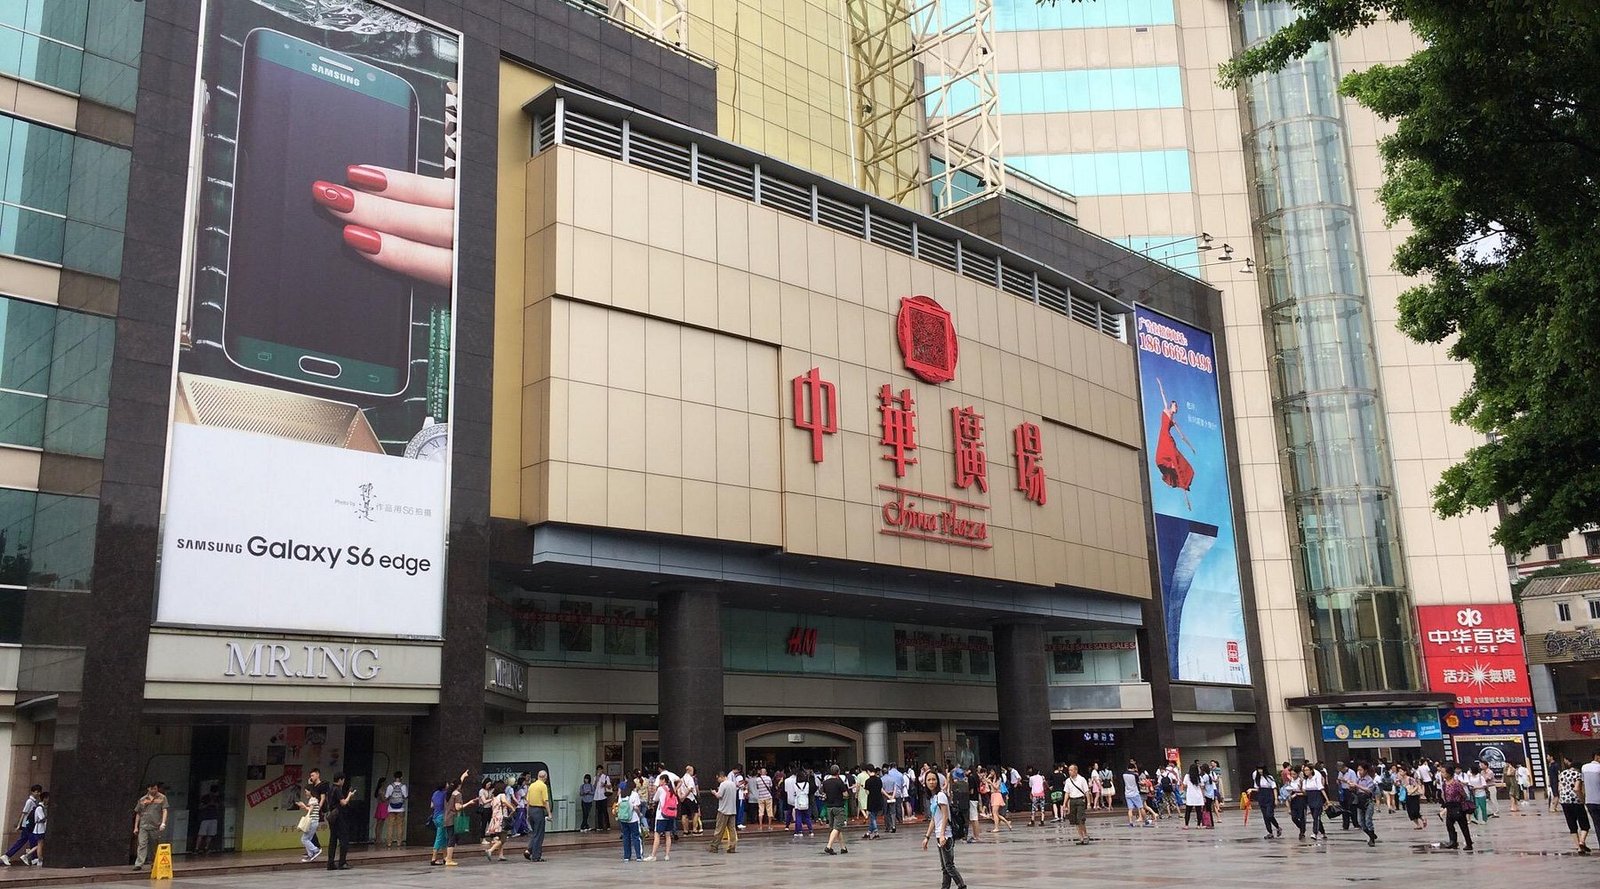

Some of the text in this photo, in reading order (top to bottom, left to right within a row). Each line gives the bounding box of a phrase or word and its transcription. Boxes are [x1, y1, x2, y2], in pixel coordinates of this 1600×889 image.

[312, 63, 360, 87] SAMSUNG
[793, 367, 1047, 505] 中華廣場
[882, 493, 938, 531] China
[177, 535, 431, 576] SAMSUNG Galaxy S6 edge
[1427, 628, 1516, 645] 中华百货
[225, 642, 381, 680] MR.ING
[1443, 669, 1469, 683] 活力
